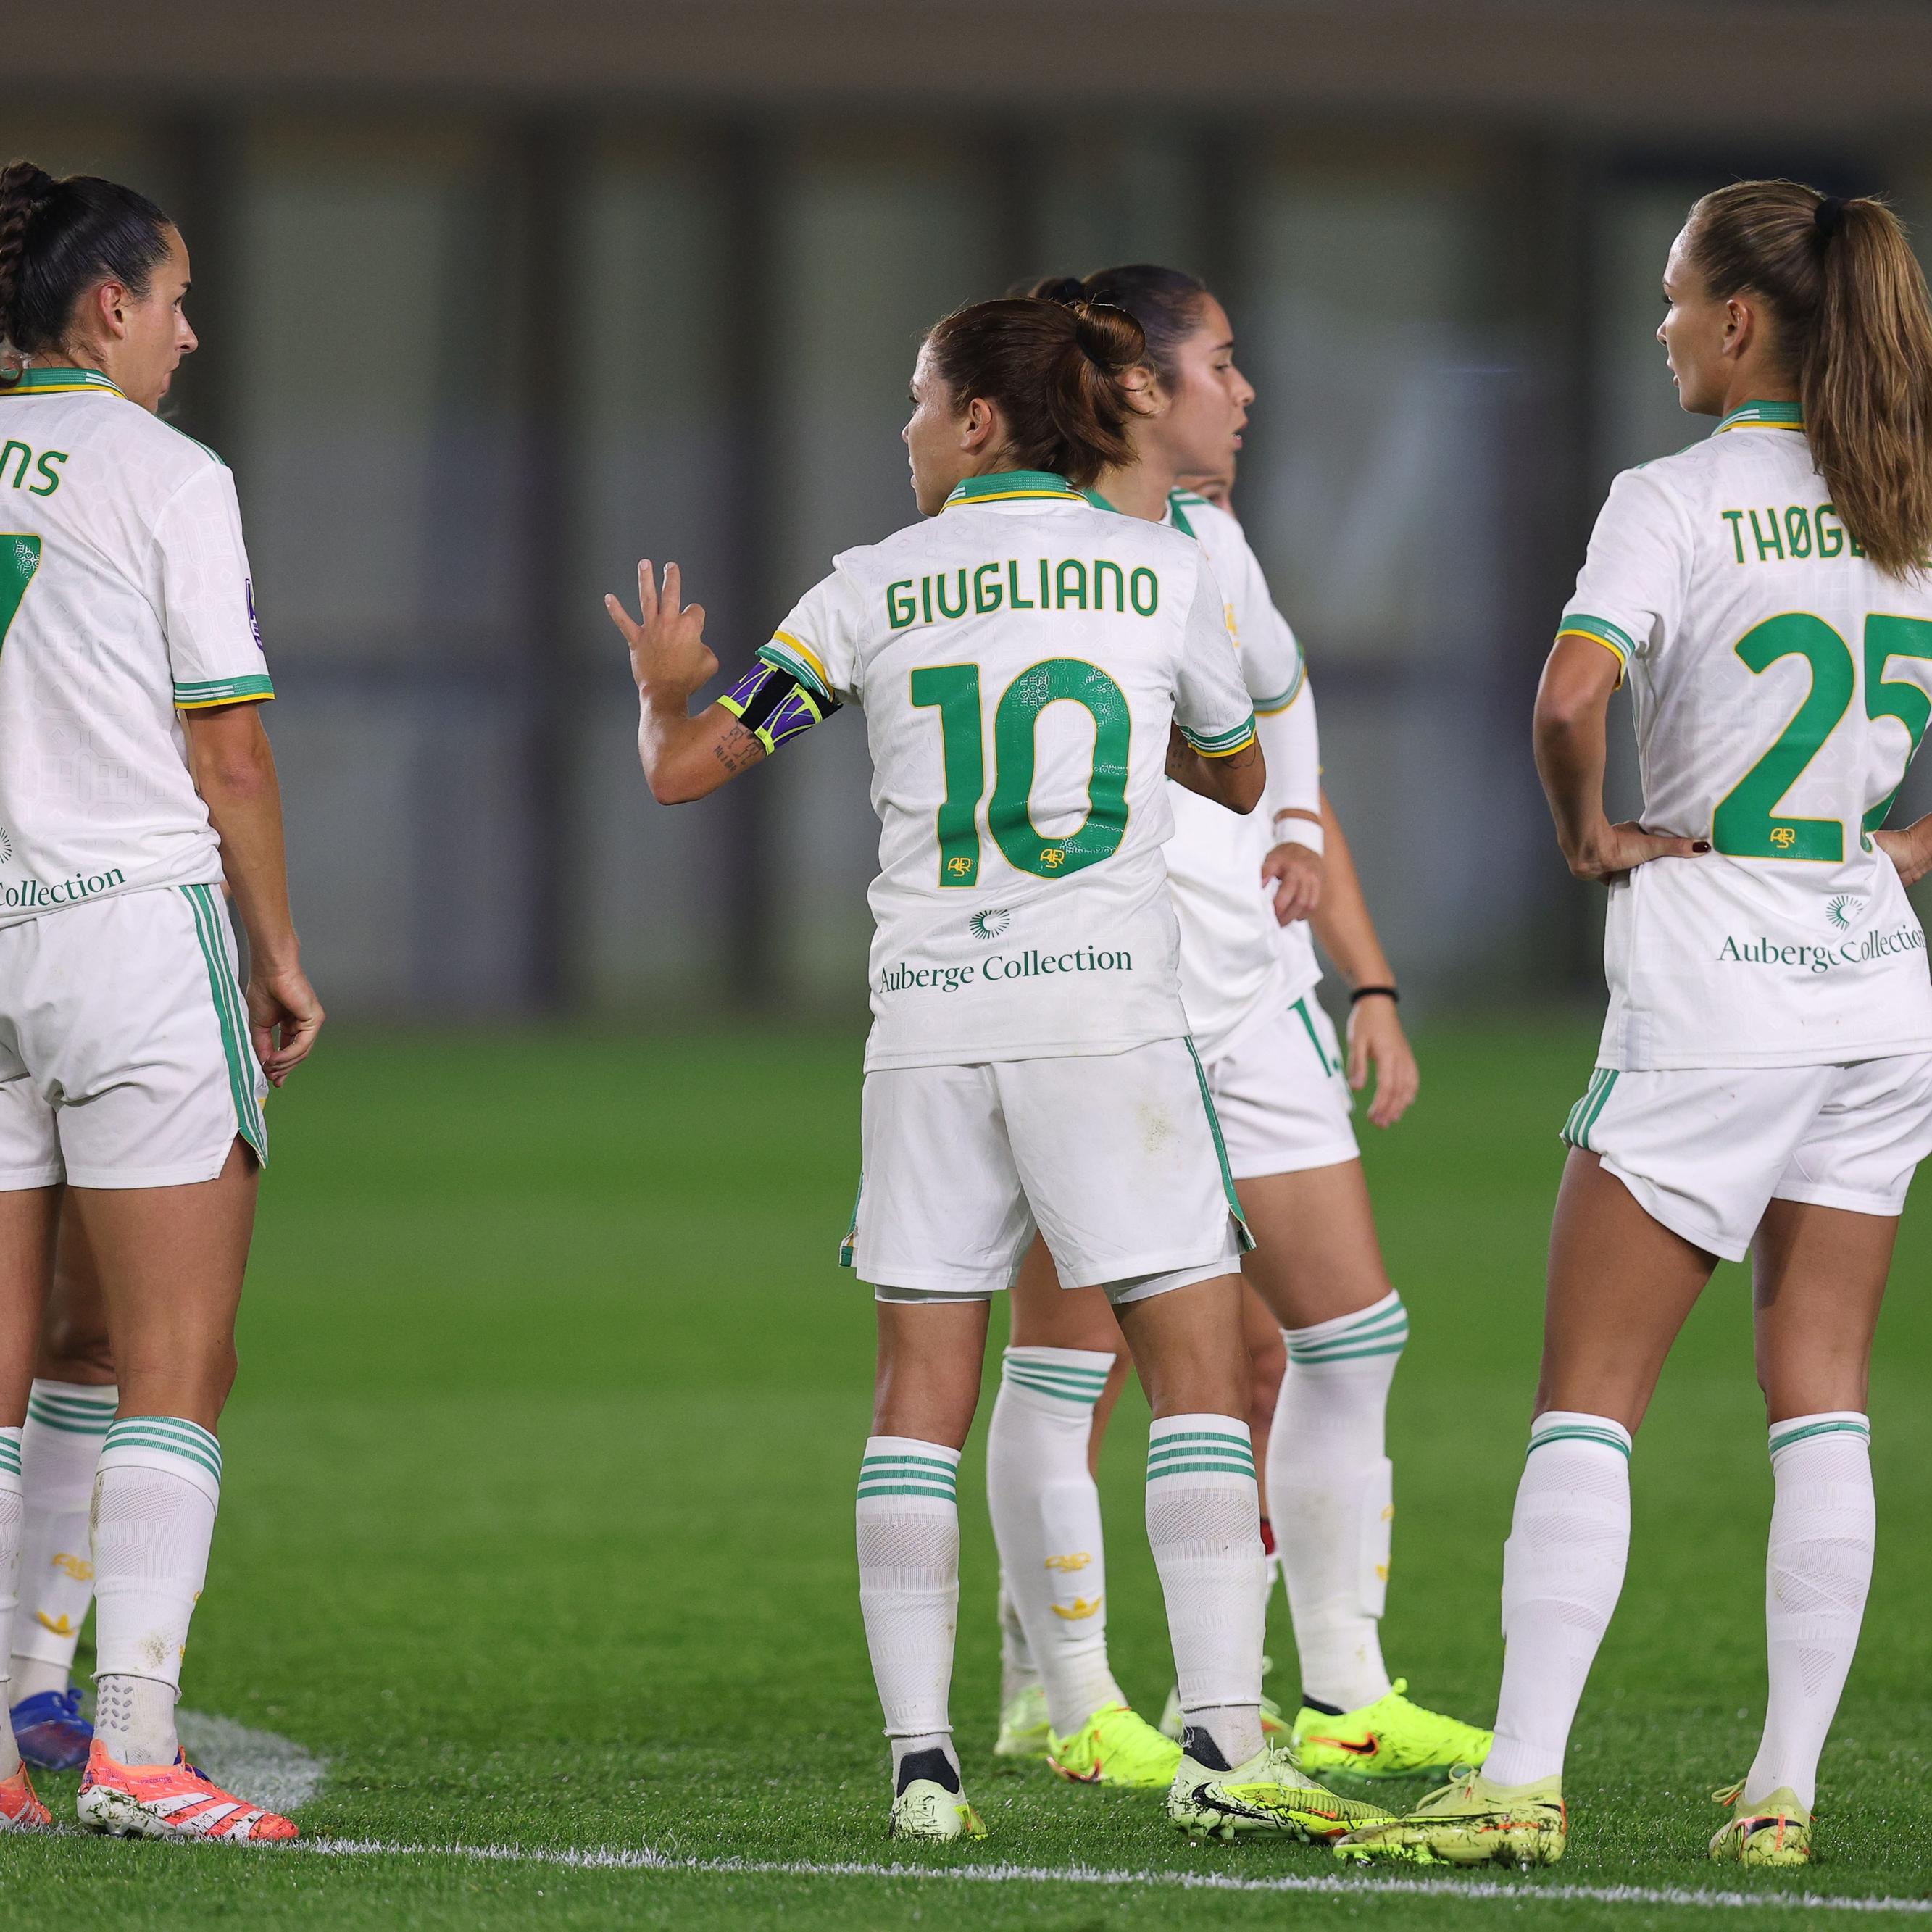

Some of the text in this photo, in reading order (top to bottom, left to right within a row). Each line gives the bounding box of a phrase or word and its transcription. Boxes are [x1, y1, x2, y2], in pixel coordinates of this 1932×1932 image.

[886, 558, 1158, 629] GIUGLIANO
[909, 657, 1133, 888] 10
[1709, 610, 1932, 864] 25
[879, 945, 1133, 993] Auberge Collection
